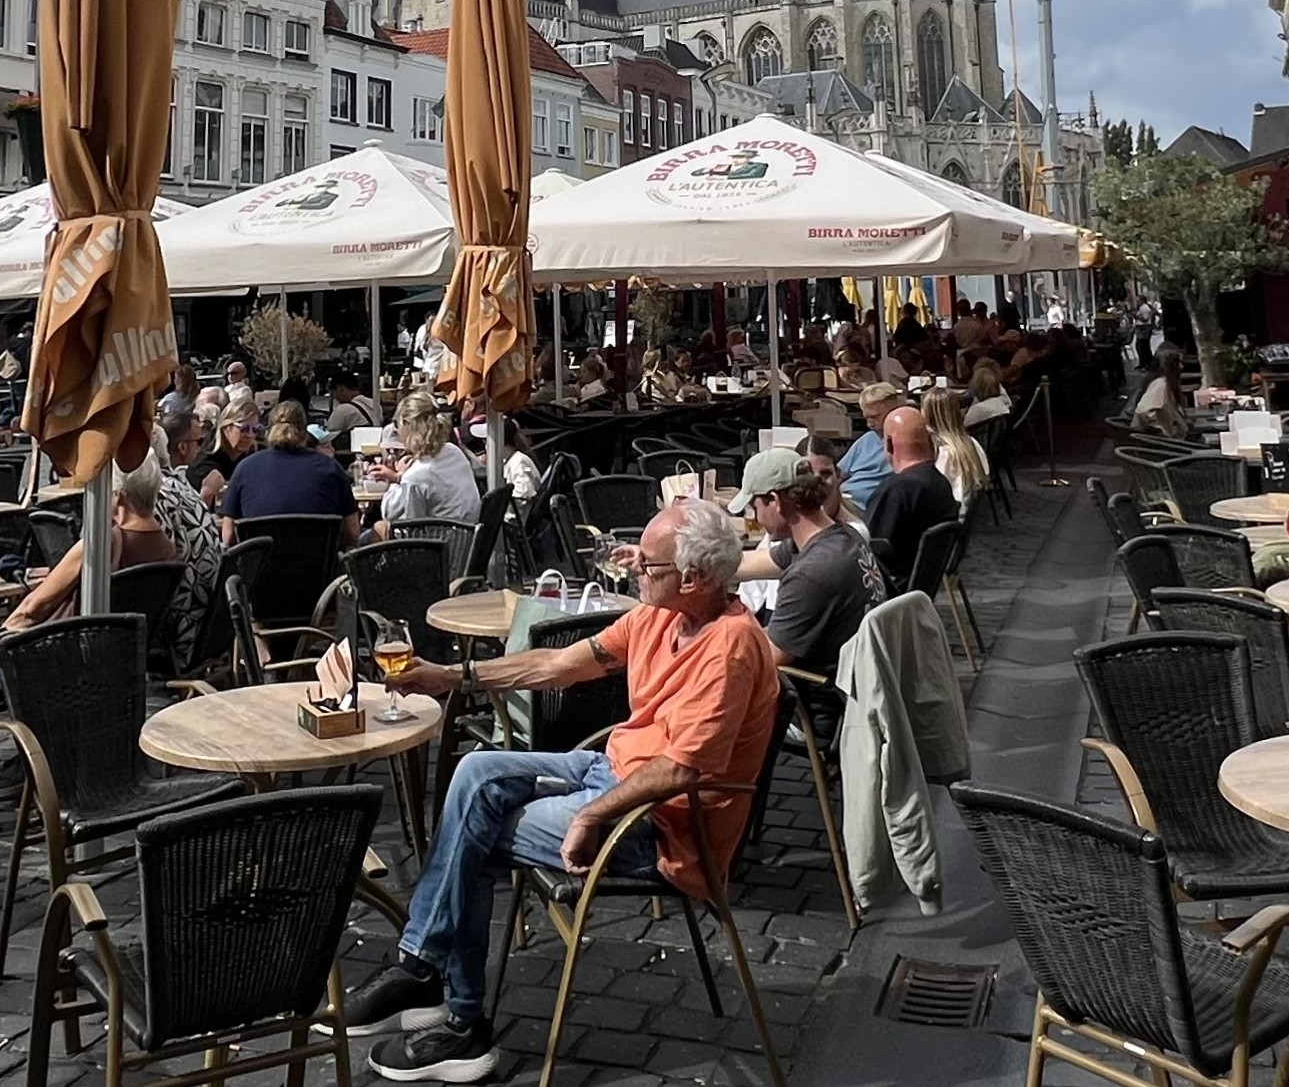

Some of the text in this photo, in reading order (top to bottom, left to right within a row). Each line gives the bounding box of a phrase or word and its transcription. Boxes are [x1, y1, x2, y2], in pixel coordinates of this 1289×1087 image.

[646, 140, 818, 182] BIRRA MORETTI
[238, 176, 316, 213] BIRRA
[323, 170, 378, 209] MORETTI
[668, 179, 779, 192] L'AUTENTICA
[807, 226, 927, 240] BIRRA MORETTI
[332, 244, 367, 254] BIRRA
